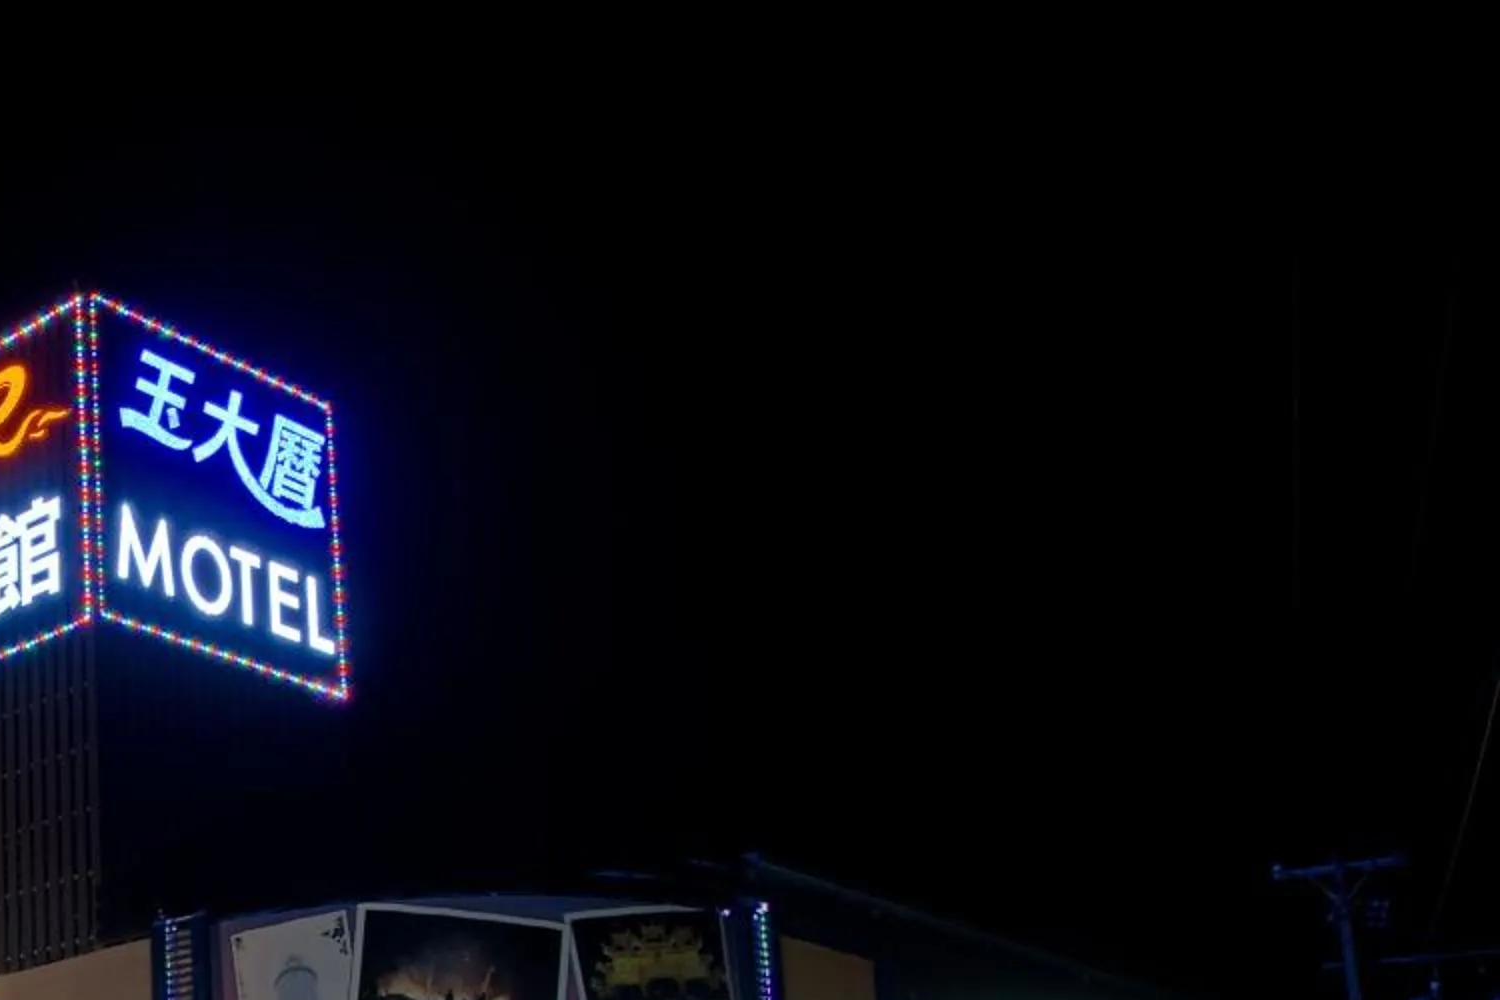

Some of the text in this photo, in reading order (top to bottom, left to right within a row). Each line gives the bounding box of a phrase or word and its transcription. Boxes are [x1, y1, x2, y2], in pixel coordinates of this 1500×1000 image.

[119, 349, 326, 529] 玉大曆
[117, 502, 336, 656] MOTEL
